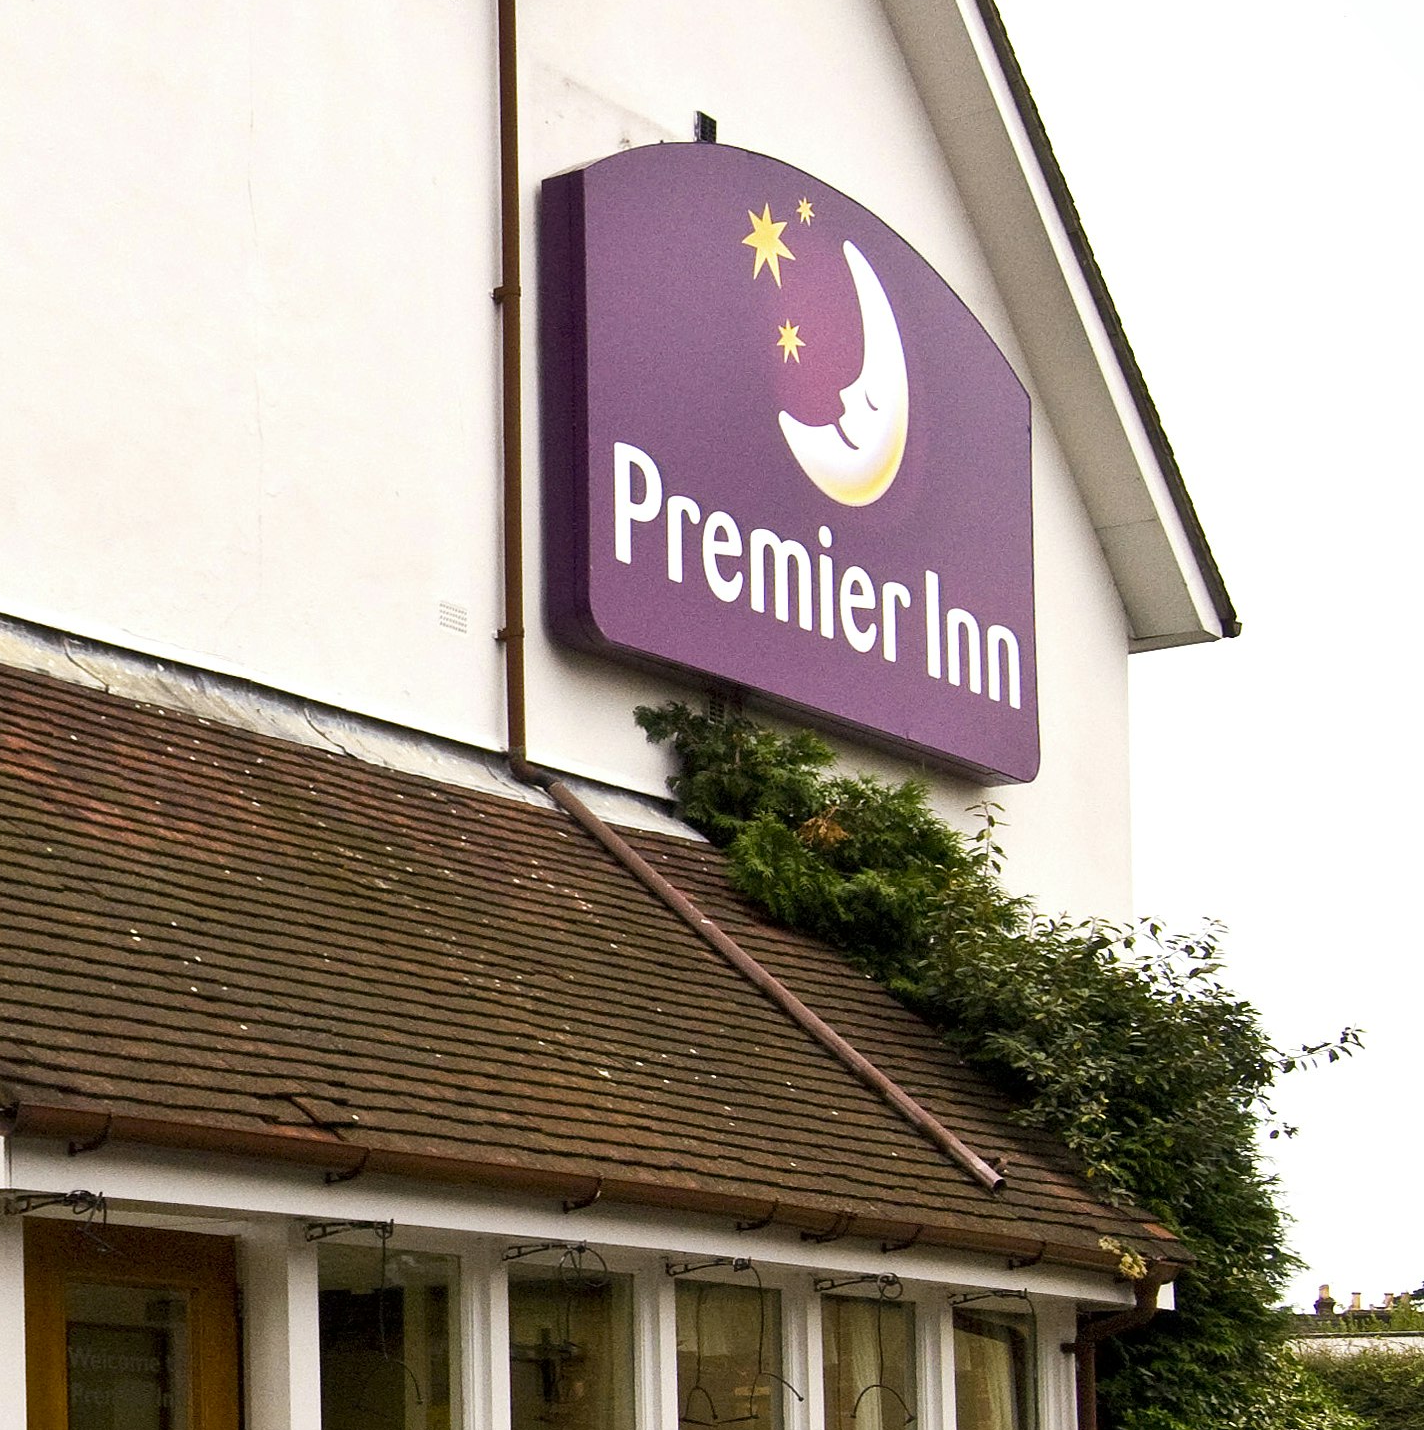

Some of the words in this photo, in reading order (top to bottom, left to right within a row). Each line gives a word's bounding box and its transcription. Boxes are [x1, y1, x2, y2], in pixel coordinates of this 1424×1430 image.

[613, 440, 912, 664] Premier
[925, 568, 1022, 710] Inn
[68, 1346, 161, 1373] Welcome
